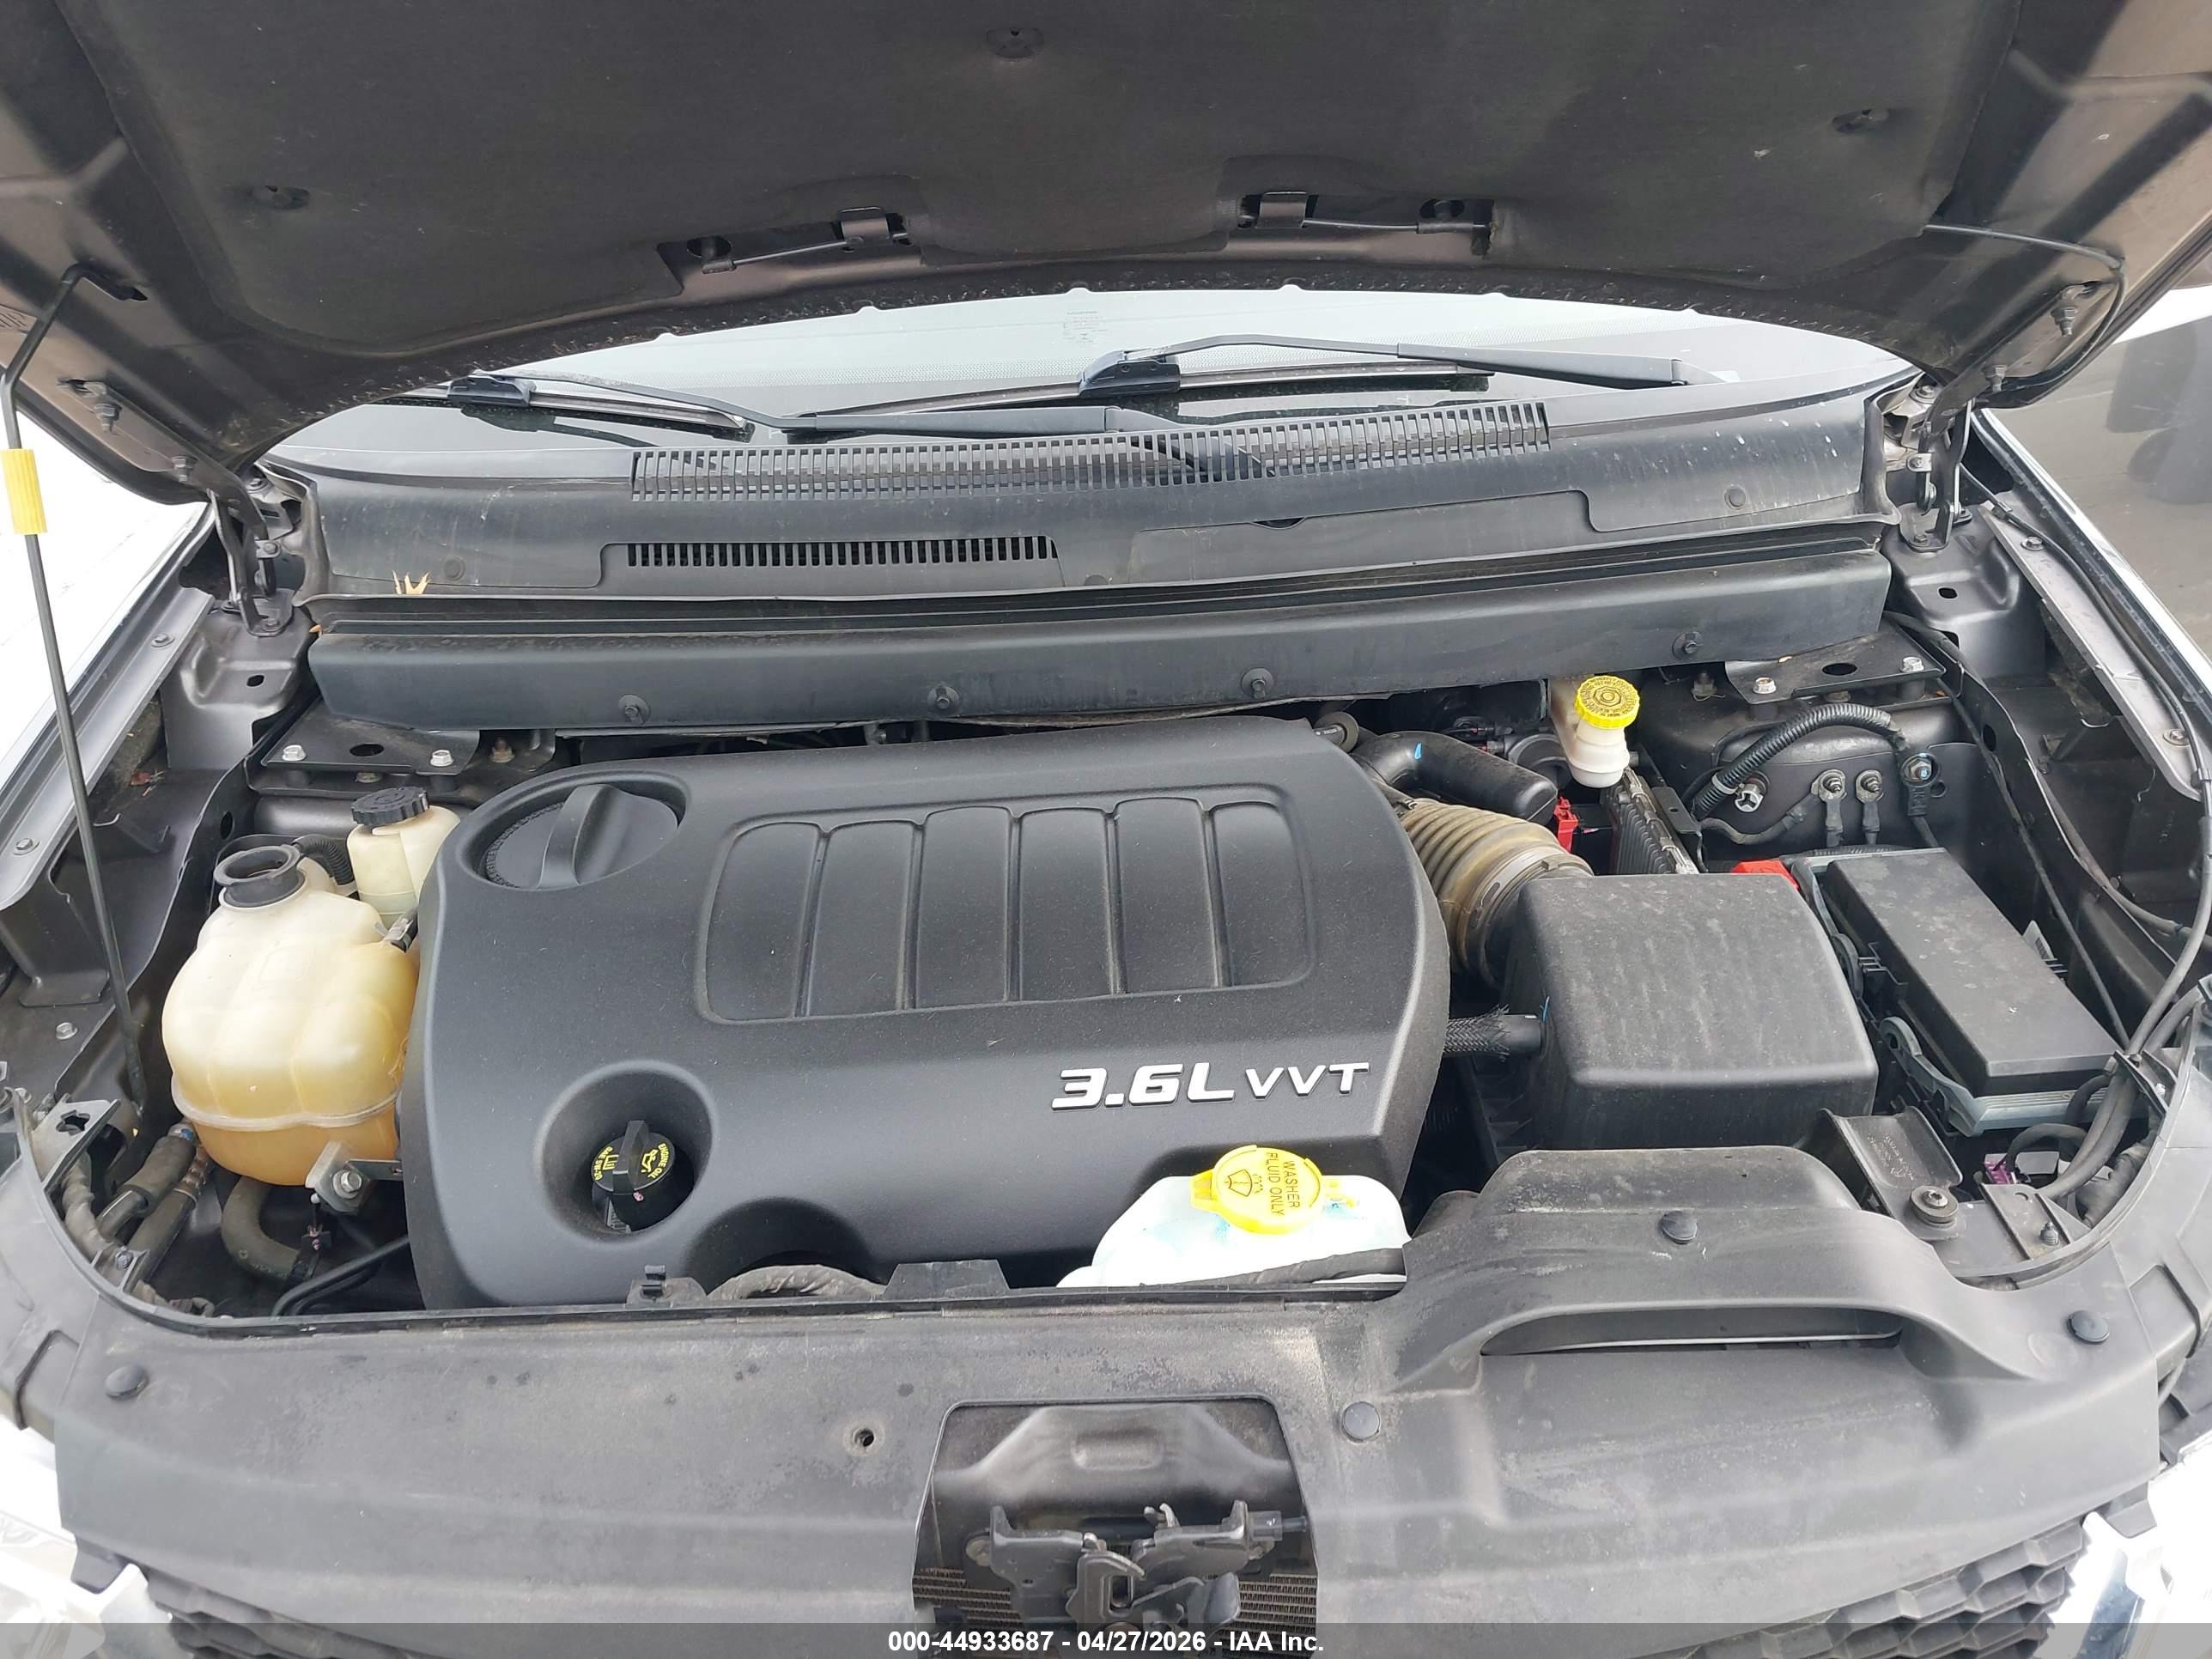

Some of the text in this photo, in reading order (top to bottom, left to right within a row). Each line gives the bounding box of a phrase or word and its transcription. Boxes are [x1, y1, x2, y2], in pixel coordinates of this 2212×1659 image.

[1050, 1061, 1370, 1110] 3.6L VVT
[599, 1146, 613, 1159] SAE
[647, 1143, 670, 1179] ENGINE OIL
[1266, 1152, 1285, 1216] FLUID ONLY
[1283, 1161, 1300, 1208] WASHER
